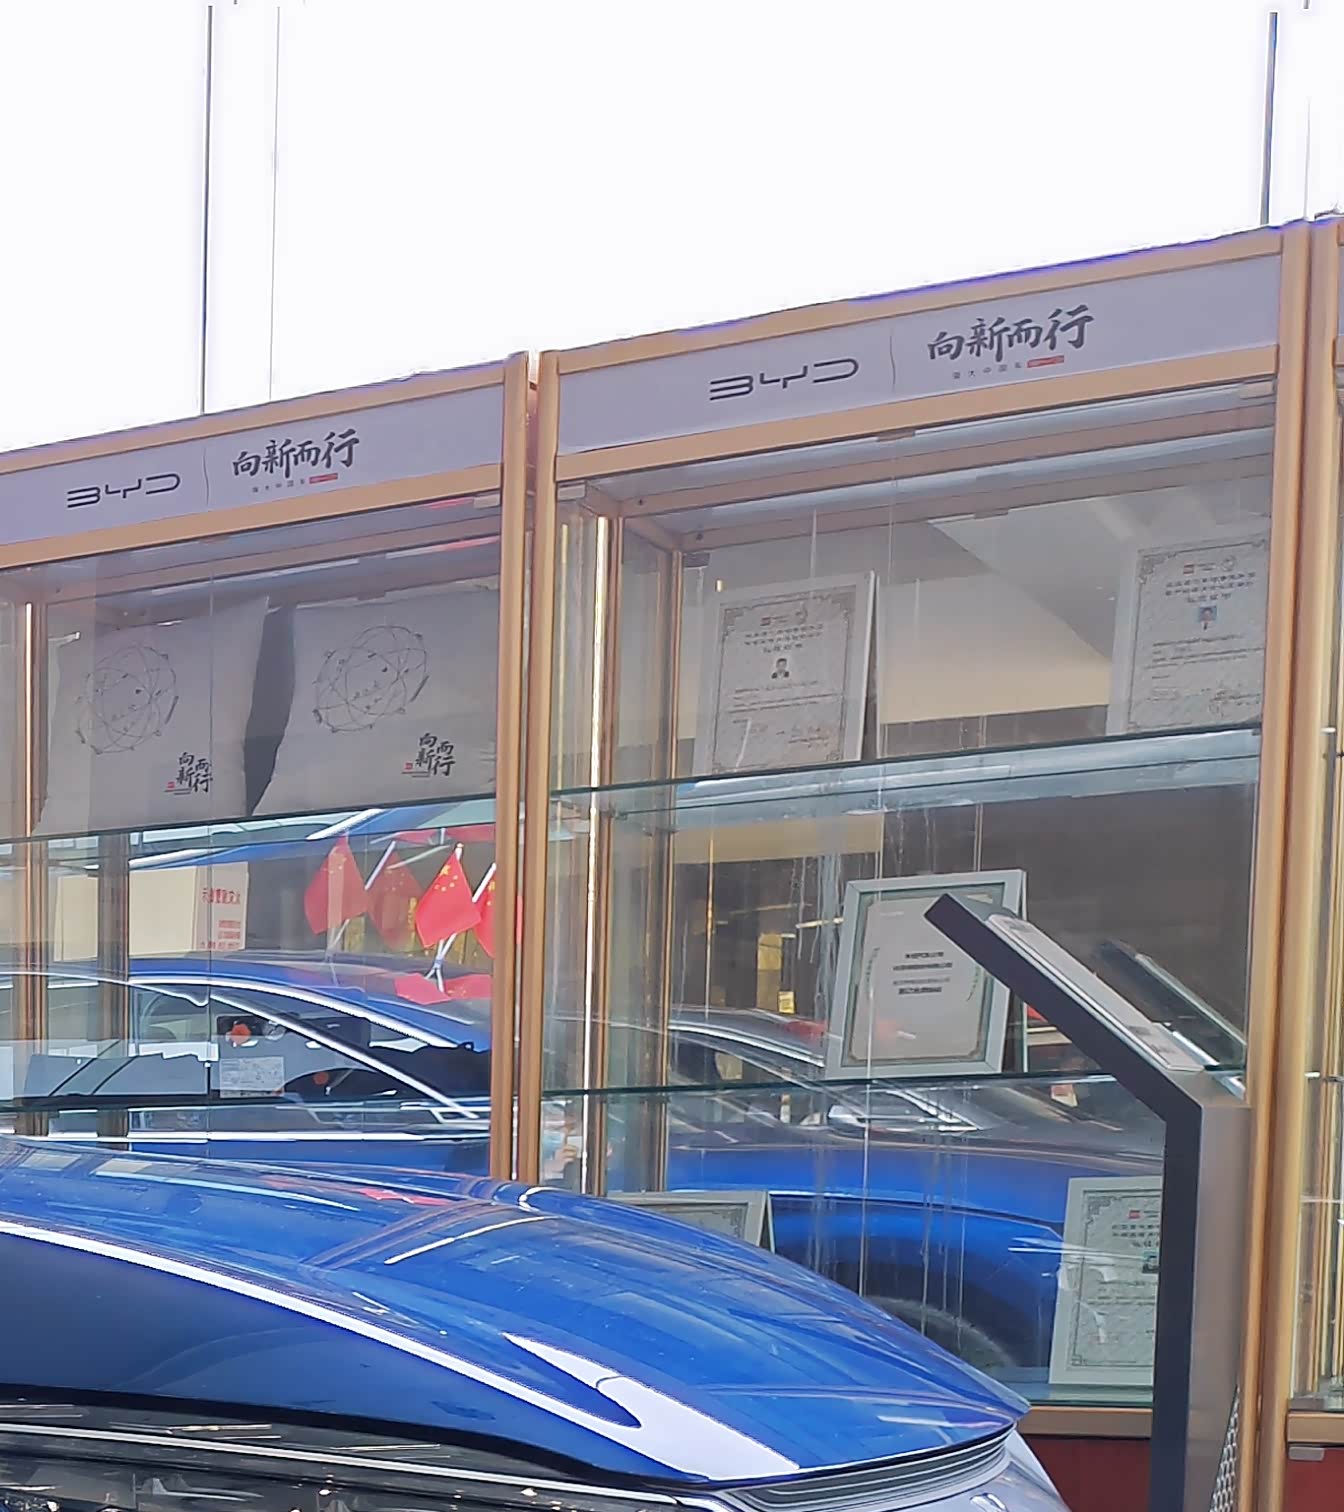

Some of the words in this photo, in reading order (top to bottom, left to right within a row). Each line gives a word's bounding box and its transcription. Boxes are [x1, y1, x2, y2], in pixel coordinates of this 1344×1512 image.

[927, 304, 1095, 363] 向新而行
[709, 358, 860, 401] BYD
[232, 428, 360, 479] 向新而行
[67, 472, 181, 509] BYD
